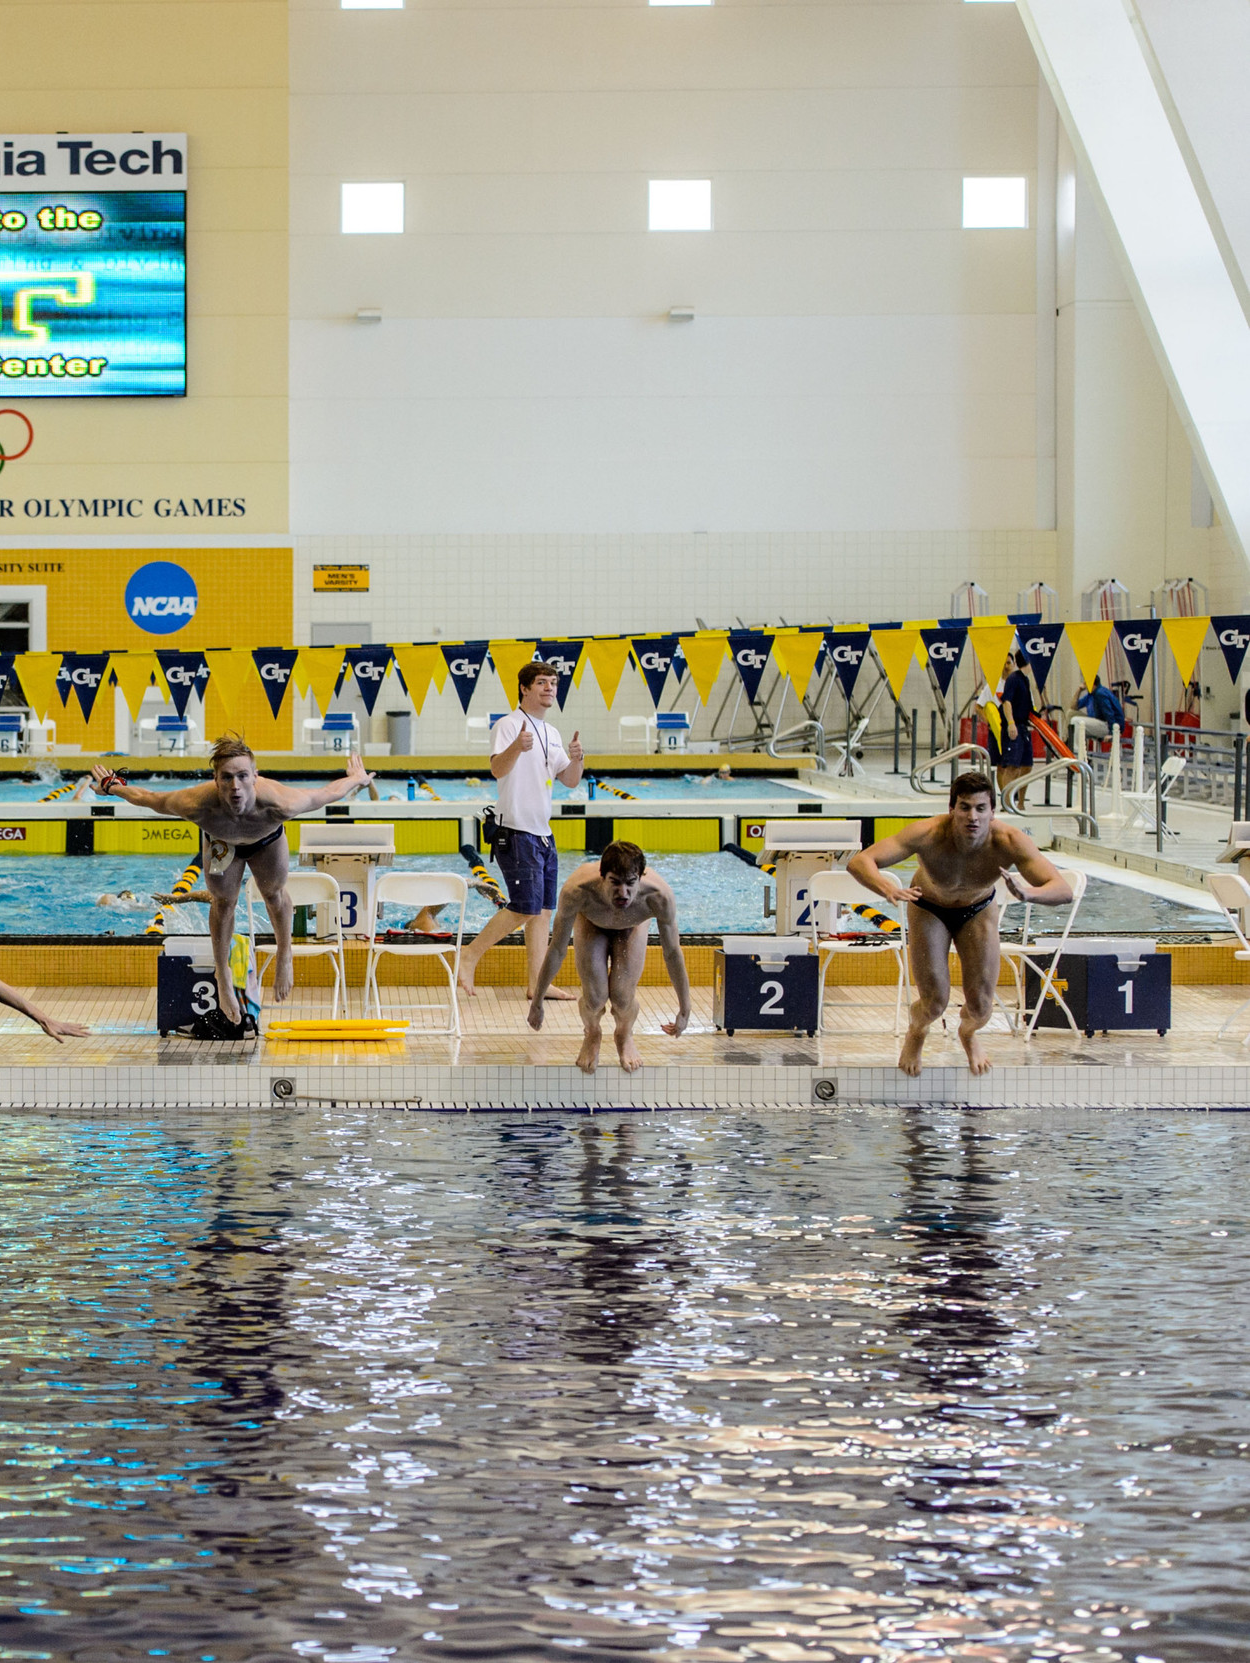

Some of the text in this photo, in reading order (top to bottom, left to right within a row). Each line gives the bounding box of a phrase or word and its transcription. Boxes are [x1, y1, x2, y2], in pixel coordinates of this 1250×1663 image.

[57, 140, 183, 176] Tech
[38, 206, 103, 230] the
[23, 499, 144, 518] OLYMPIC
[153, 498, 246, 517] GAMES
[28, 562, 65, 573] SUITE
[131, 596, 196, 616] NCAA
[1025, 637, 1055, 657] GT
[1123, 633, 1152, 653] GT
[1220, 629, 1250, 648] GT
[737, 649, 766, 669] GT
[833, 645, 862, 664] GT
[929, 642, 958, 661] GT
[354, 661, 384, 680] GT
[450, 659, 479, 678] GT
[640, 652, 670, 671] GT
[71, 668, 101, 687] GT
[166, 666, 195, 685] GT
[260, 663, 290, 682] GT
[0, 739, 9, 752] 6
[168, 738, 176, 752] 7
[333, 737, 342, 751] 8
[340, 891, 357, 928] 3
[191, 981, 217, 1015] 3
[759, 980, 785, 1015] 2
[1117, 980, 1133, 1014] 1
